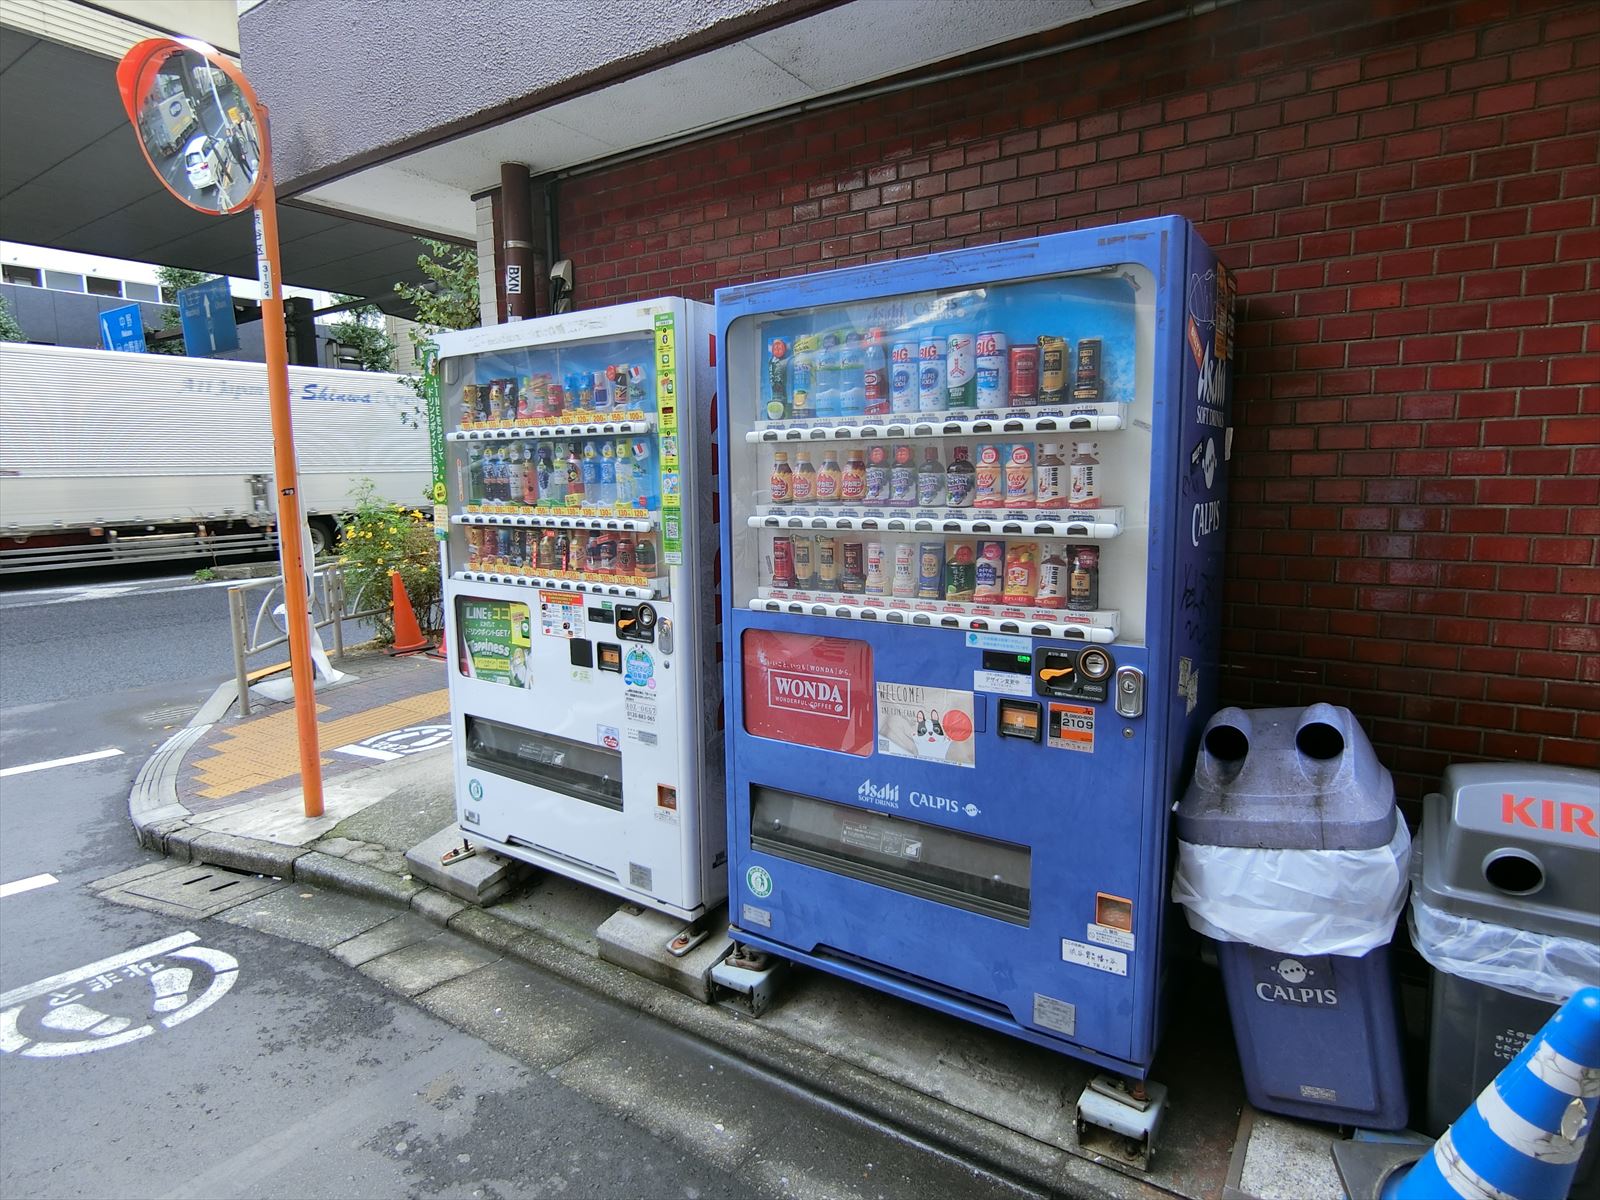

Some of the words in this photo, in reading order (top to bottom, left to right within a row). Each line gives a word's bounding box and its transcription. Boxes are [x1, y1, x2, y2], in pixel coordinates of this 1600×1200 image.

[262, 265, 270, 297] 3154
[302, 383, 371, 403] Shinwa
[1192, 501, 1219, 546] CALPIS
[774, 676, 843, 703] WONDA
[775, 696, 808, 706] WONDERFUL
[810, 701, 832, 710] COFFEE
[1062, 718, 1093, 730] 2109
[858, 779, 899, 802] Asahi
[858, 795, 873, 803] SOFT
[874, 799, 899, 809] DRINKS
[909, 791, 959, 813] CALPIS
[1256, 982, 1337, 1005] CALPIS
